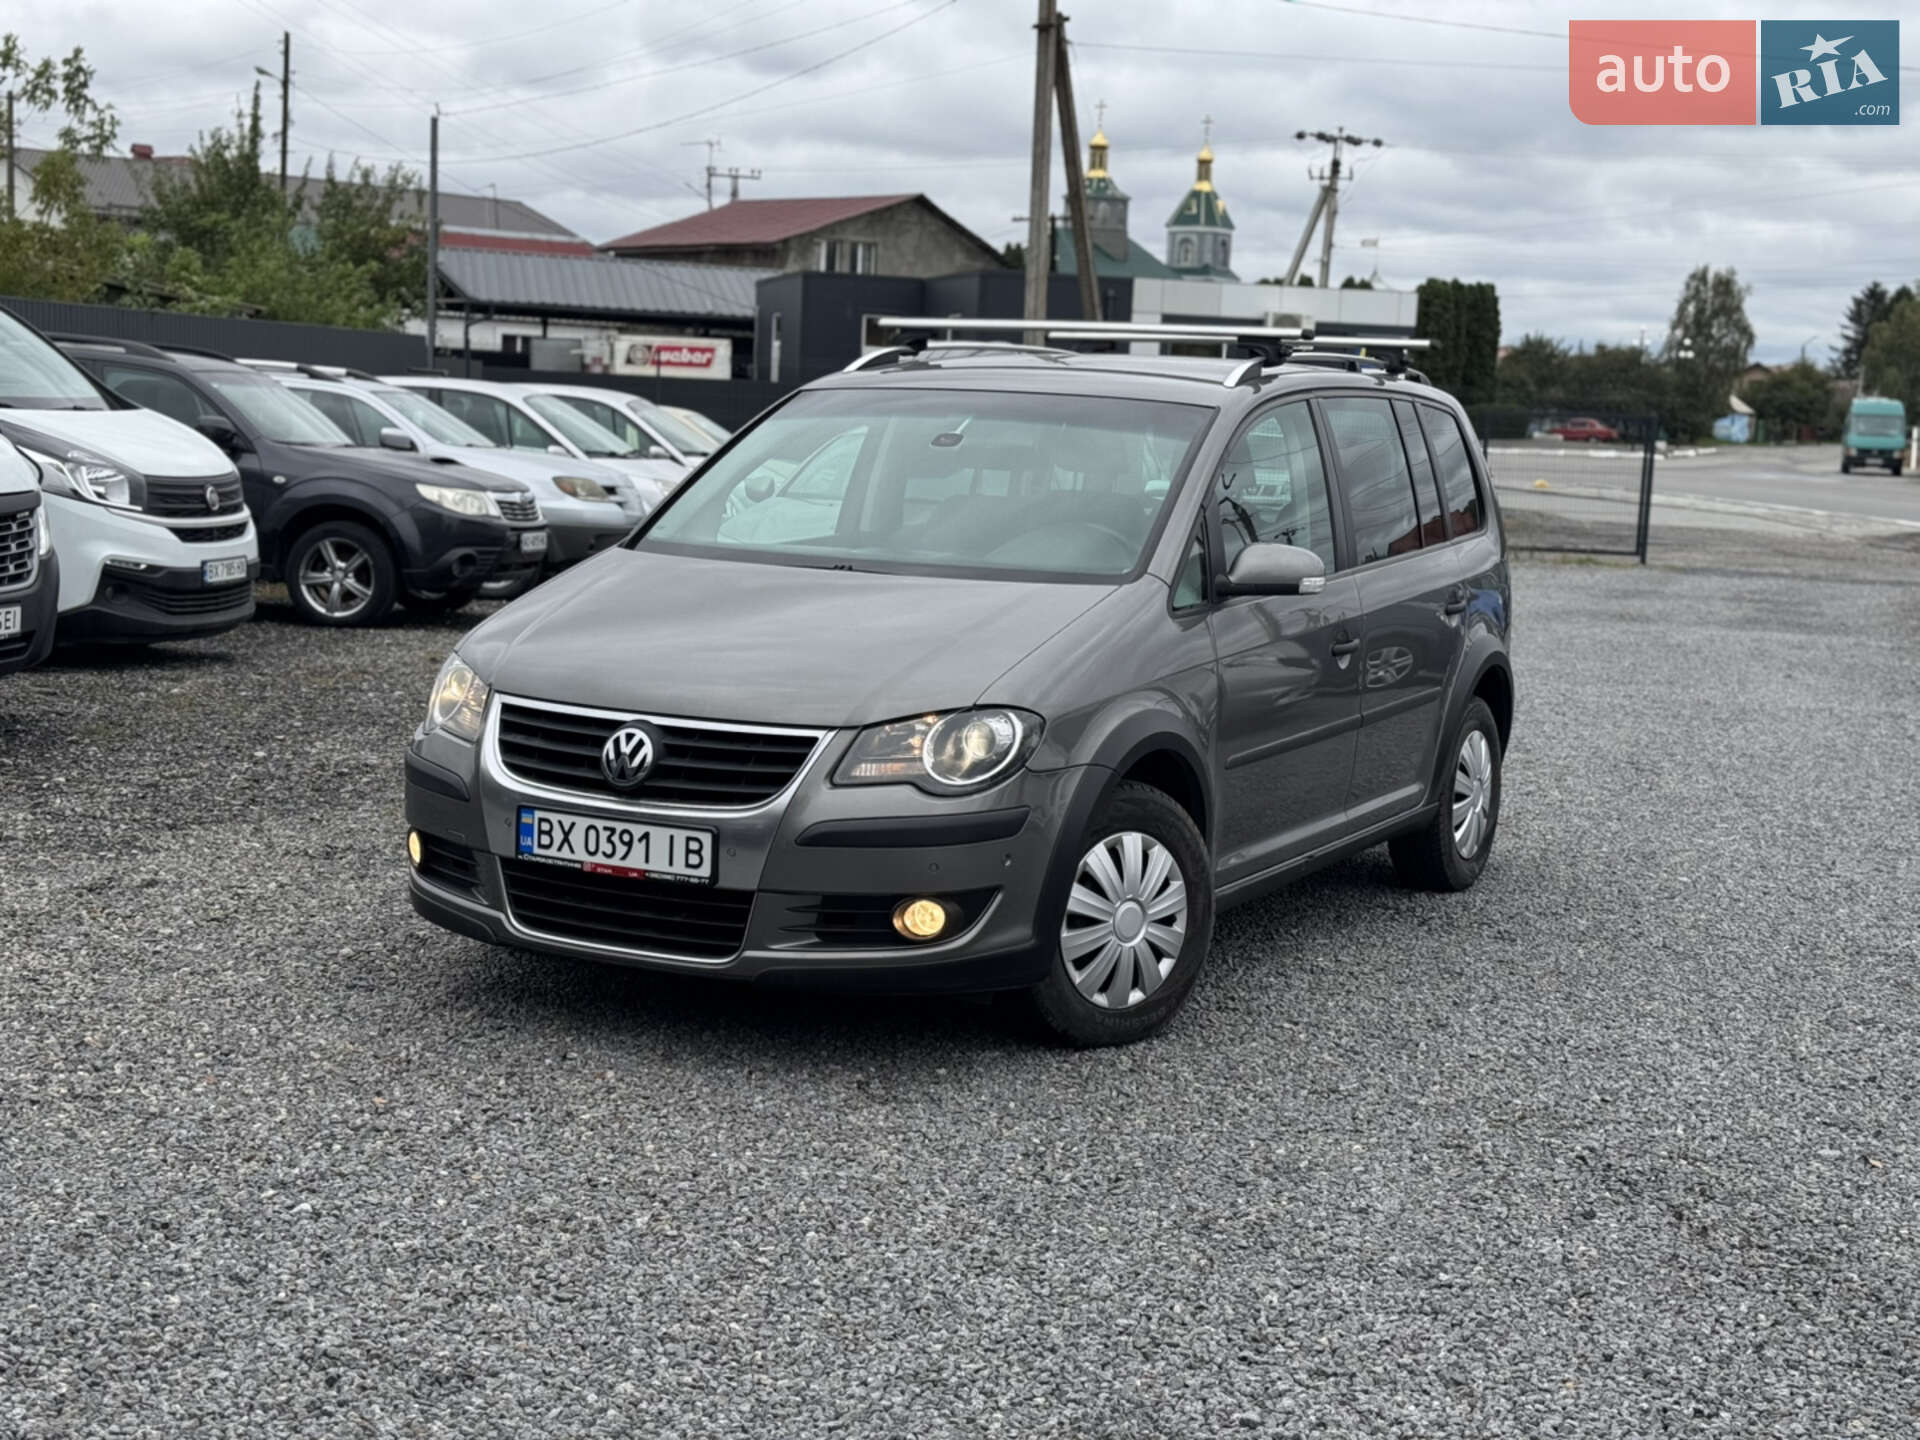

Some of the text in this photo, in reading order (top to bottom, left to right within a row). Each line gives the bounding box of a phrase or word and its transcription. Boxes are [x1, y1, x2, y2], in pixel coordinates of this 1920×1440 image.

[520, 836, 533, 847] UA
[537, 816, 577, 855] BX
[584, 824, 651, 865] 0391
[668, 834, 704, 869] IB
